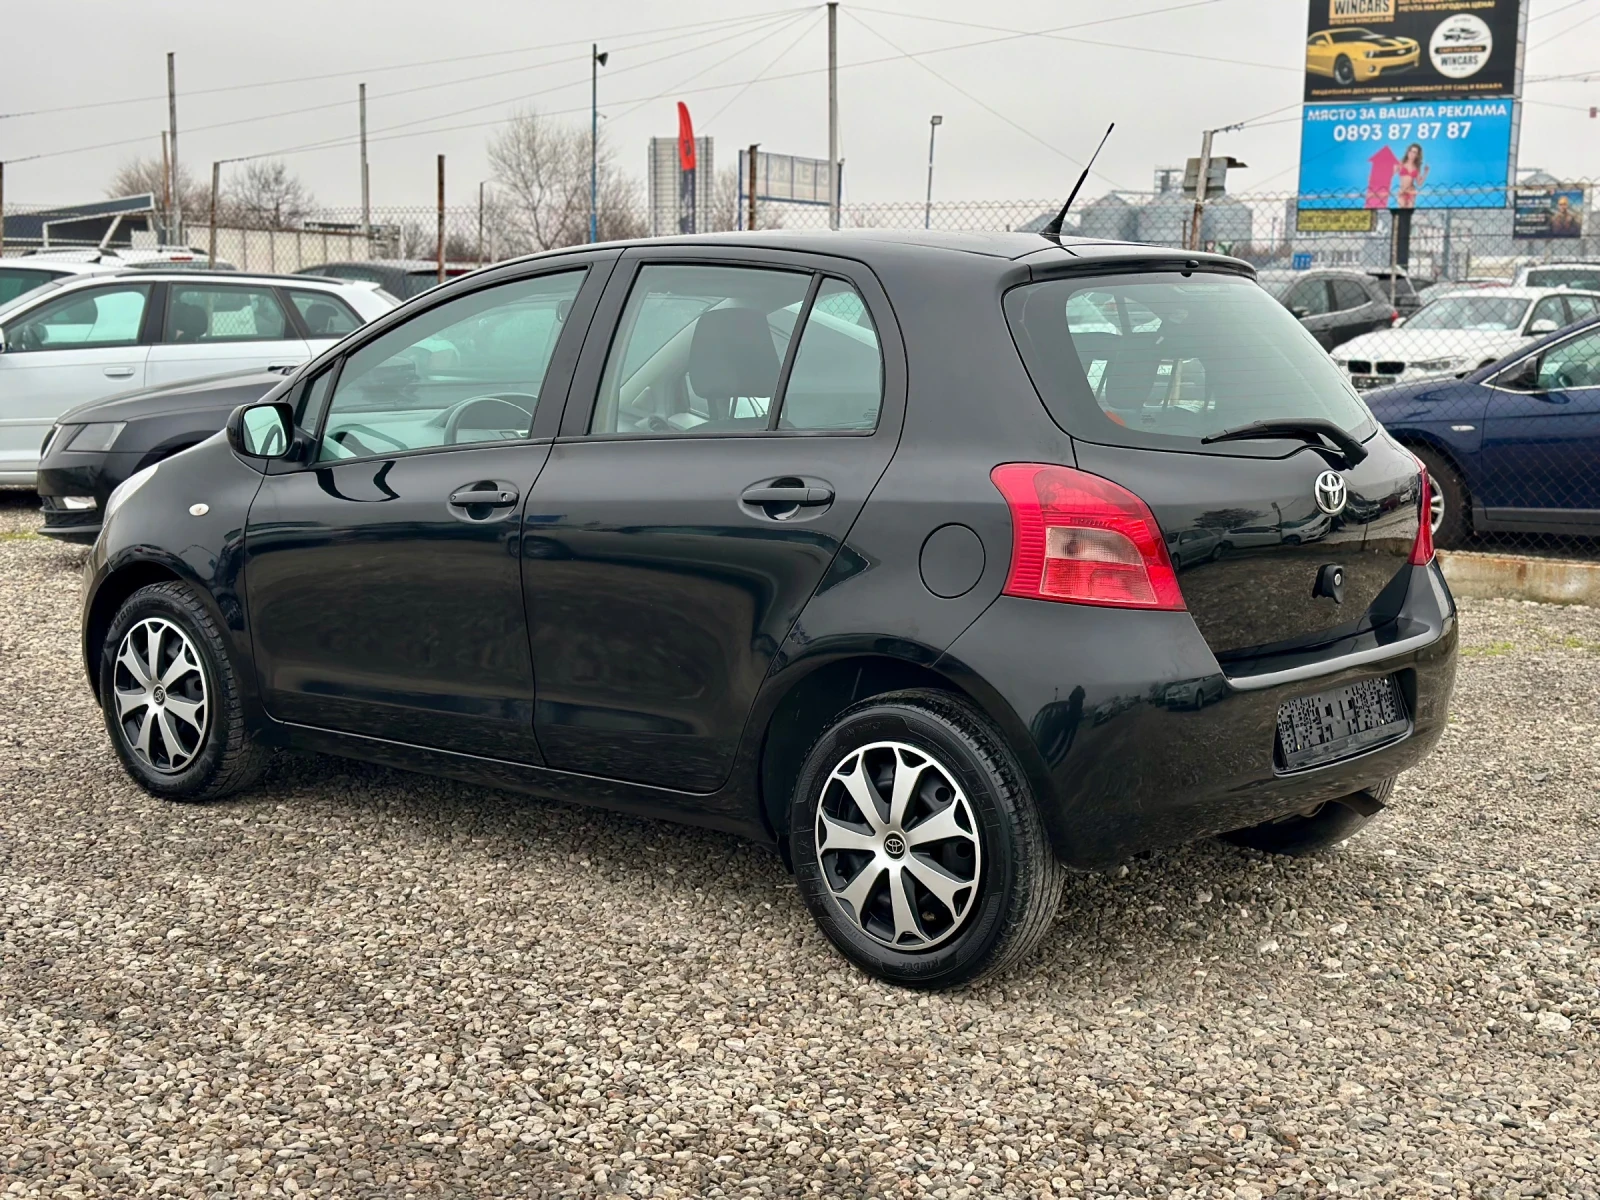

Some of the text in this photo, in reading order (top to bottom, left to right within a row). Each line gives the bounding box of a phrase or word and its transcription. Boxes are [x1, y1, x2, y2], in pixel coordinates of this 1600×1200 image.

[1335, 0, 1390, 14] WINCARS
[1441, 55, 1479, 66] WINCARS
[1308, 103, 1507, 121] МЯСТО ЗА ВАШАТА РЕКЛАМА
[1333, 121, 1472, 142] 0893 87 87 87
